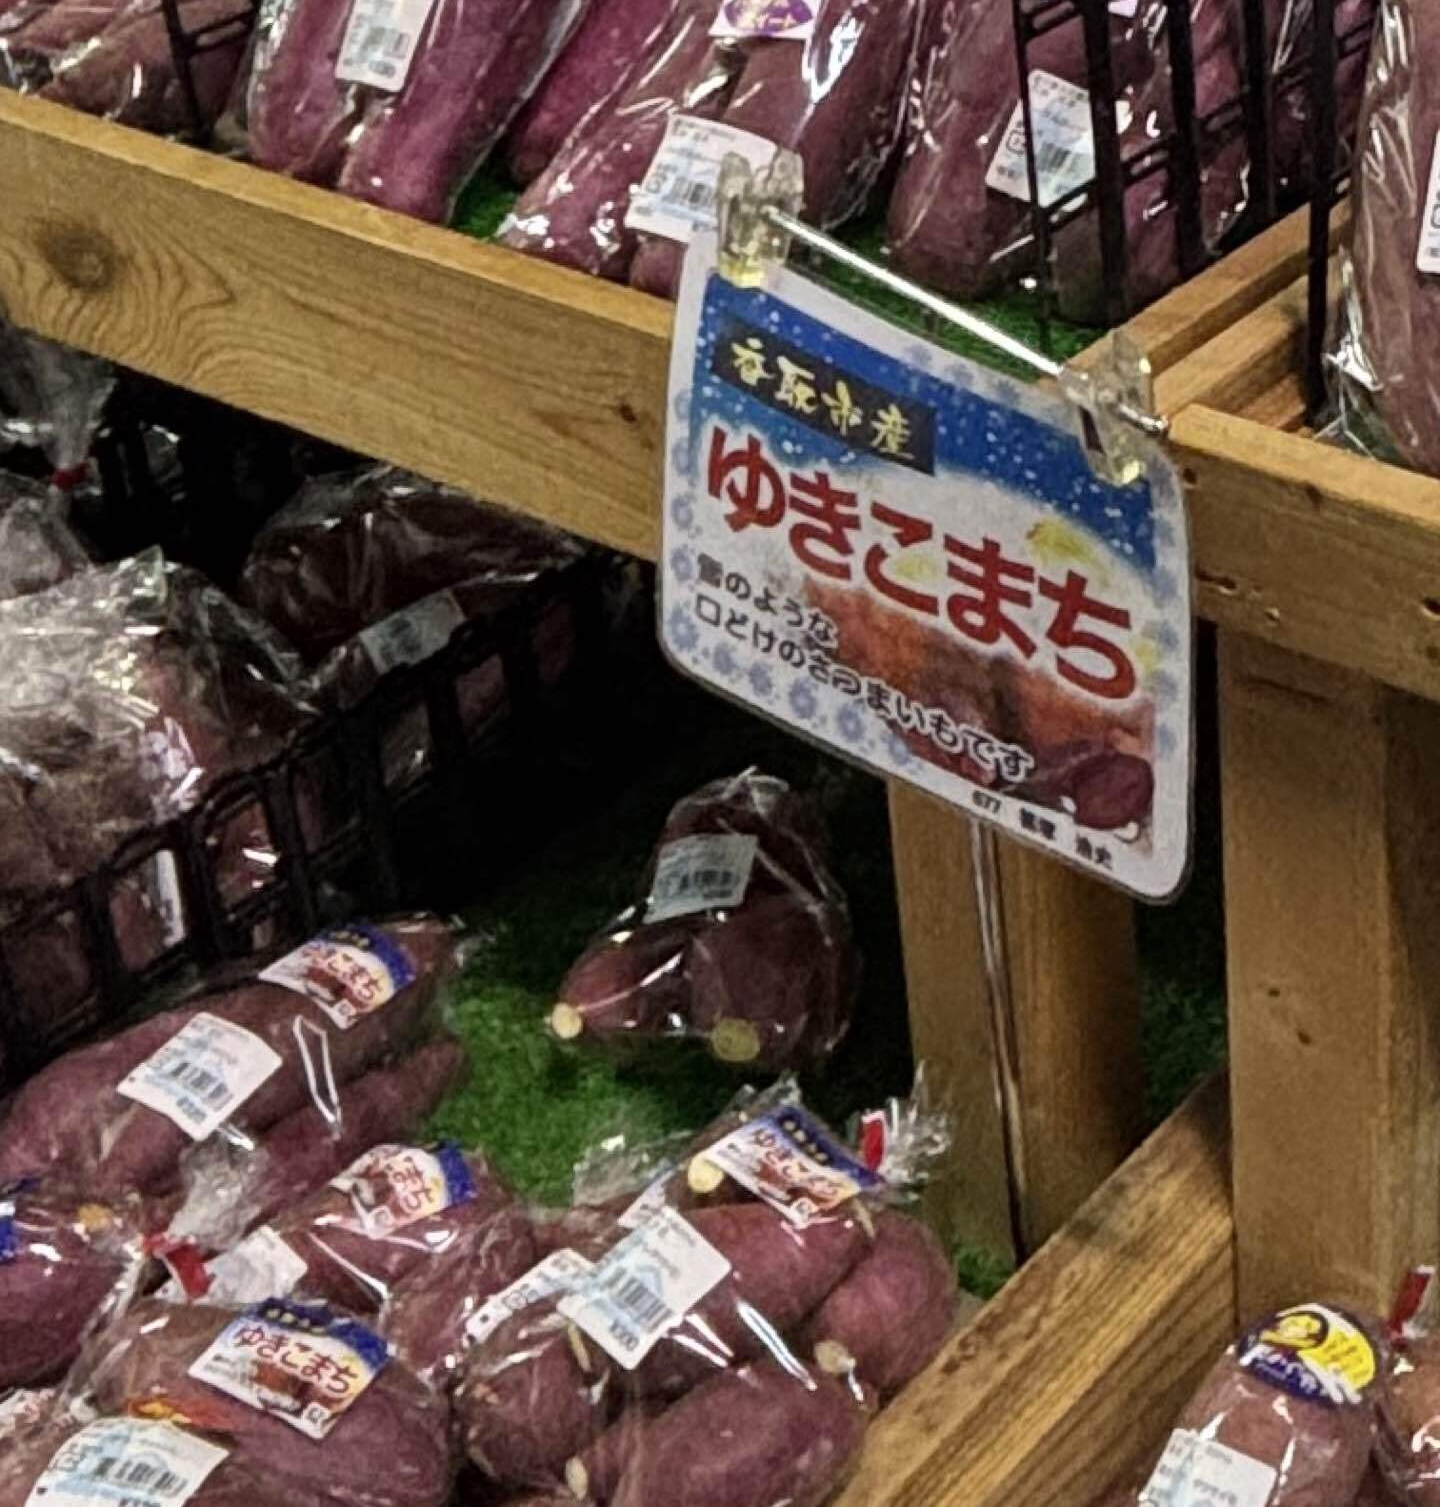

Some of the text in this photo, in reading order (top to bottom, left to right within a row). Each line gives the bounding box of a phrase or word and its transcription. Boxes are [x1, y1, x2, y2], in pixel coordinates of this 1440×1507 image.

[731, 337, 918, 463] 香取市産
[697, 552, 840, 648] 雪のような
[707, 426, 1138, 701] ゆきこまち
[695, 595, 1036, 783] 口どけのさつまいもです
[236, 1324, 358, 1400] ゆきこまち
